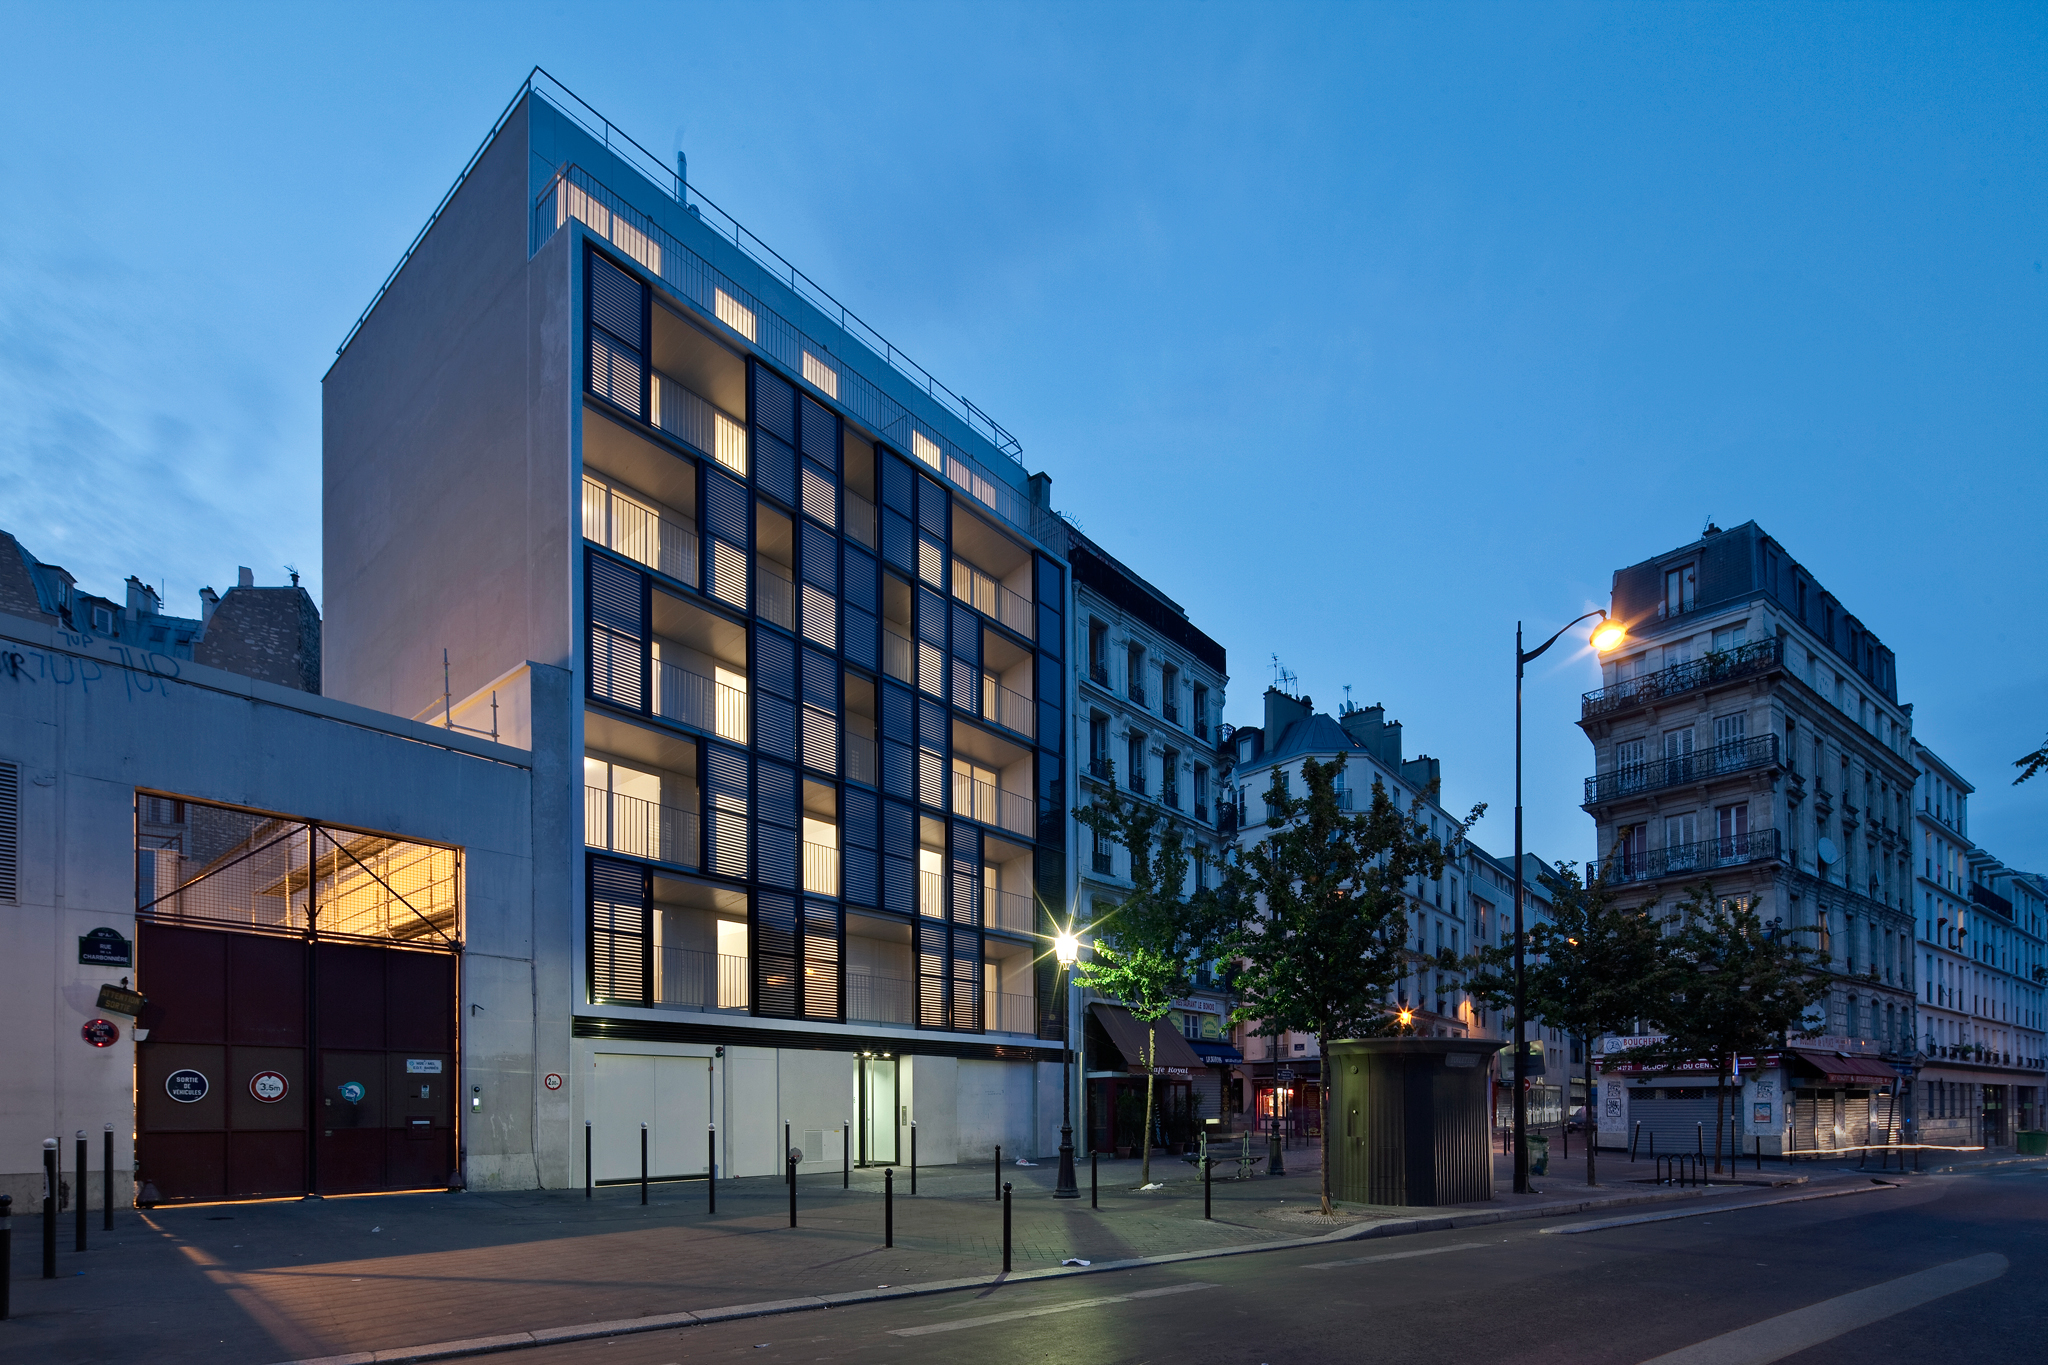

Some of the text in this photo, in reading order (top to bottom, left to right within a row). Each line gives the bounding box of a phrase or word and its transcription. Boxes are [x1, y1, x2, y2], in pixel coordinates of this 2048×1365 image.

[57, 631, 94, 648] 7UP
[29, 651, 102, 694] 7UP
[83, 953, 128, 962] CHARBONNIÈRE
[101, 989, 141, 1005] ATTENTION
[105, 1000, 132, 1012] SORTIE
[1168, 1067, 1188, 1075] Royal
